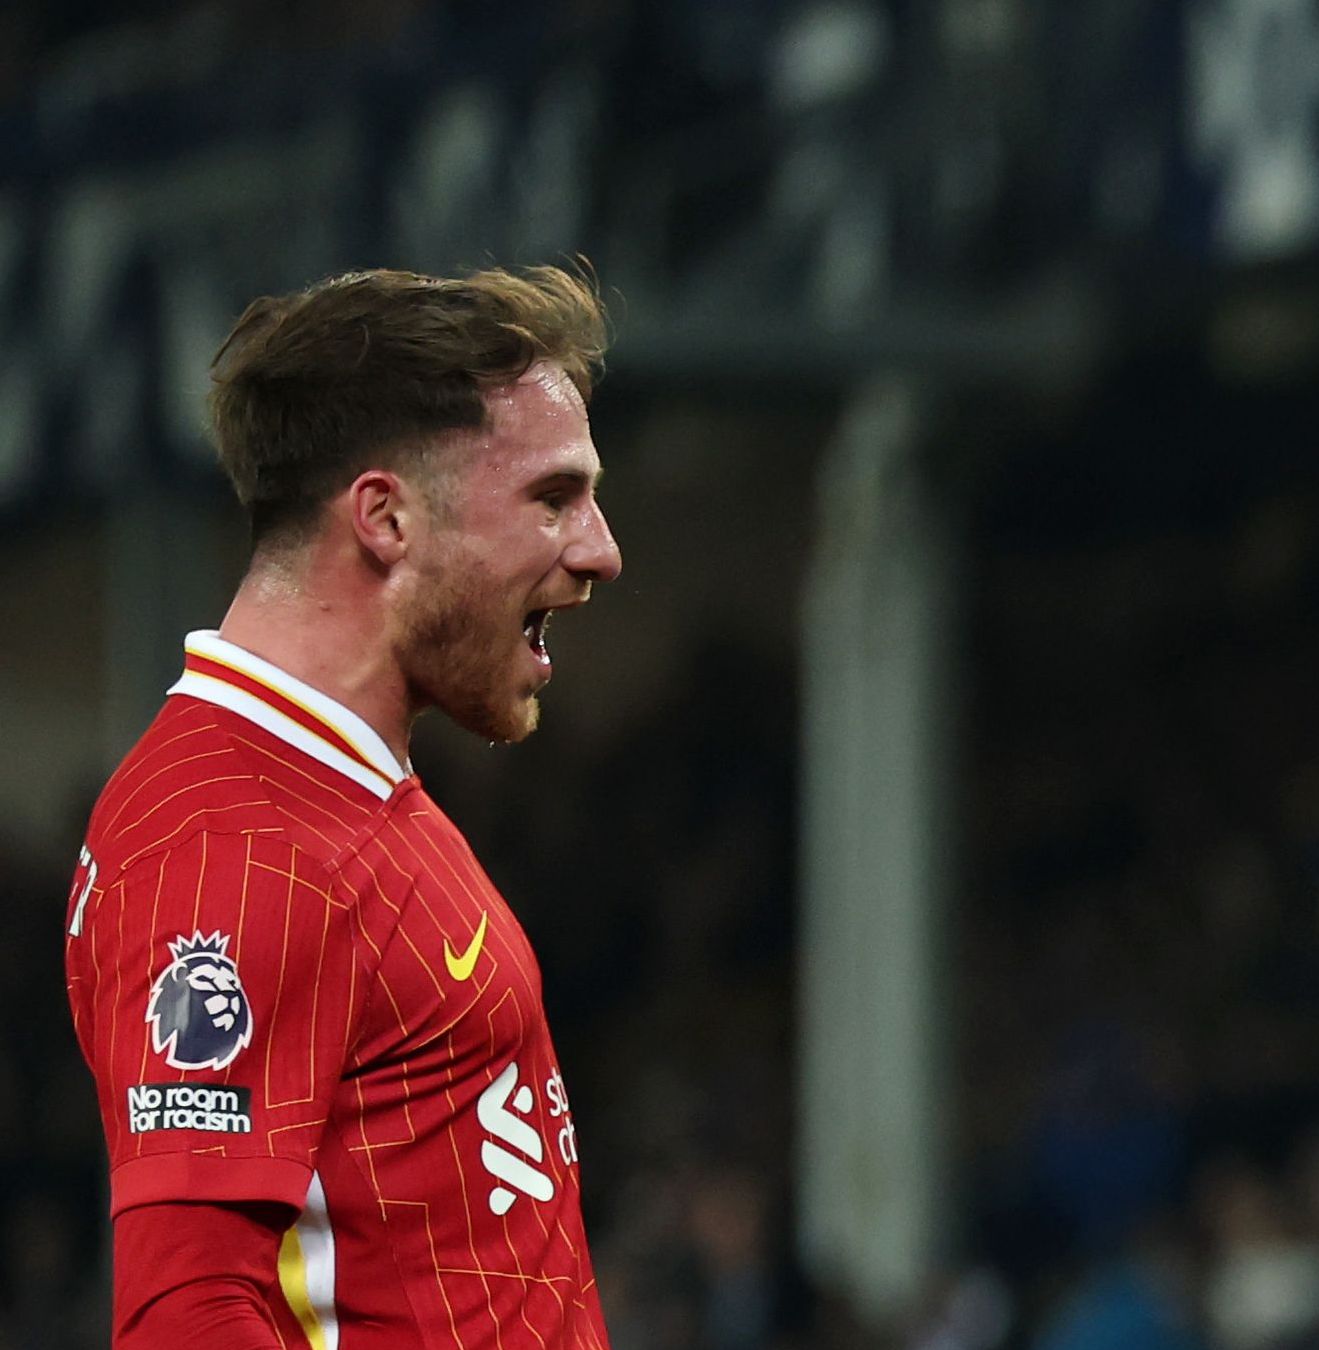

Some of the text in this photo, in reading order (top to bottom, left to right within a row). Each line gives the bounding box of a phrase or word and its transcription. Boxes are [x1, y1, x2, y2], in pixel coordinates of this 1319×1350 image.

[128, 1086, 238, 1111] No room
[130, 1109, 251, 1133] for racism
